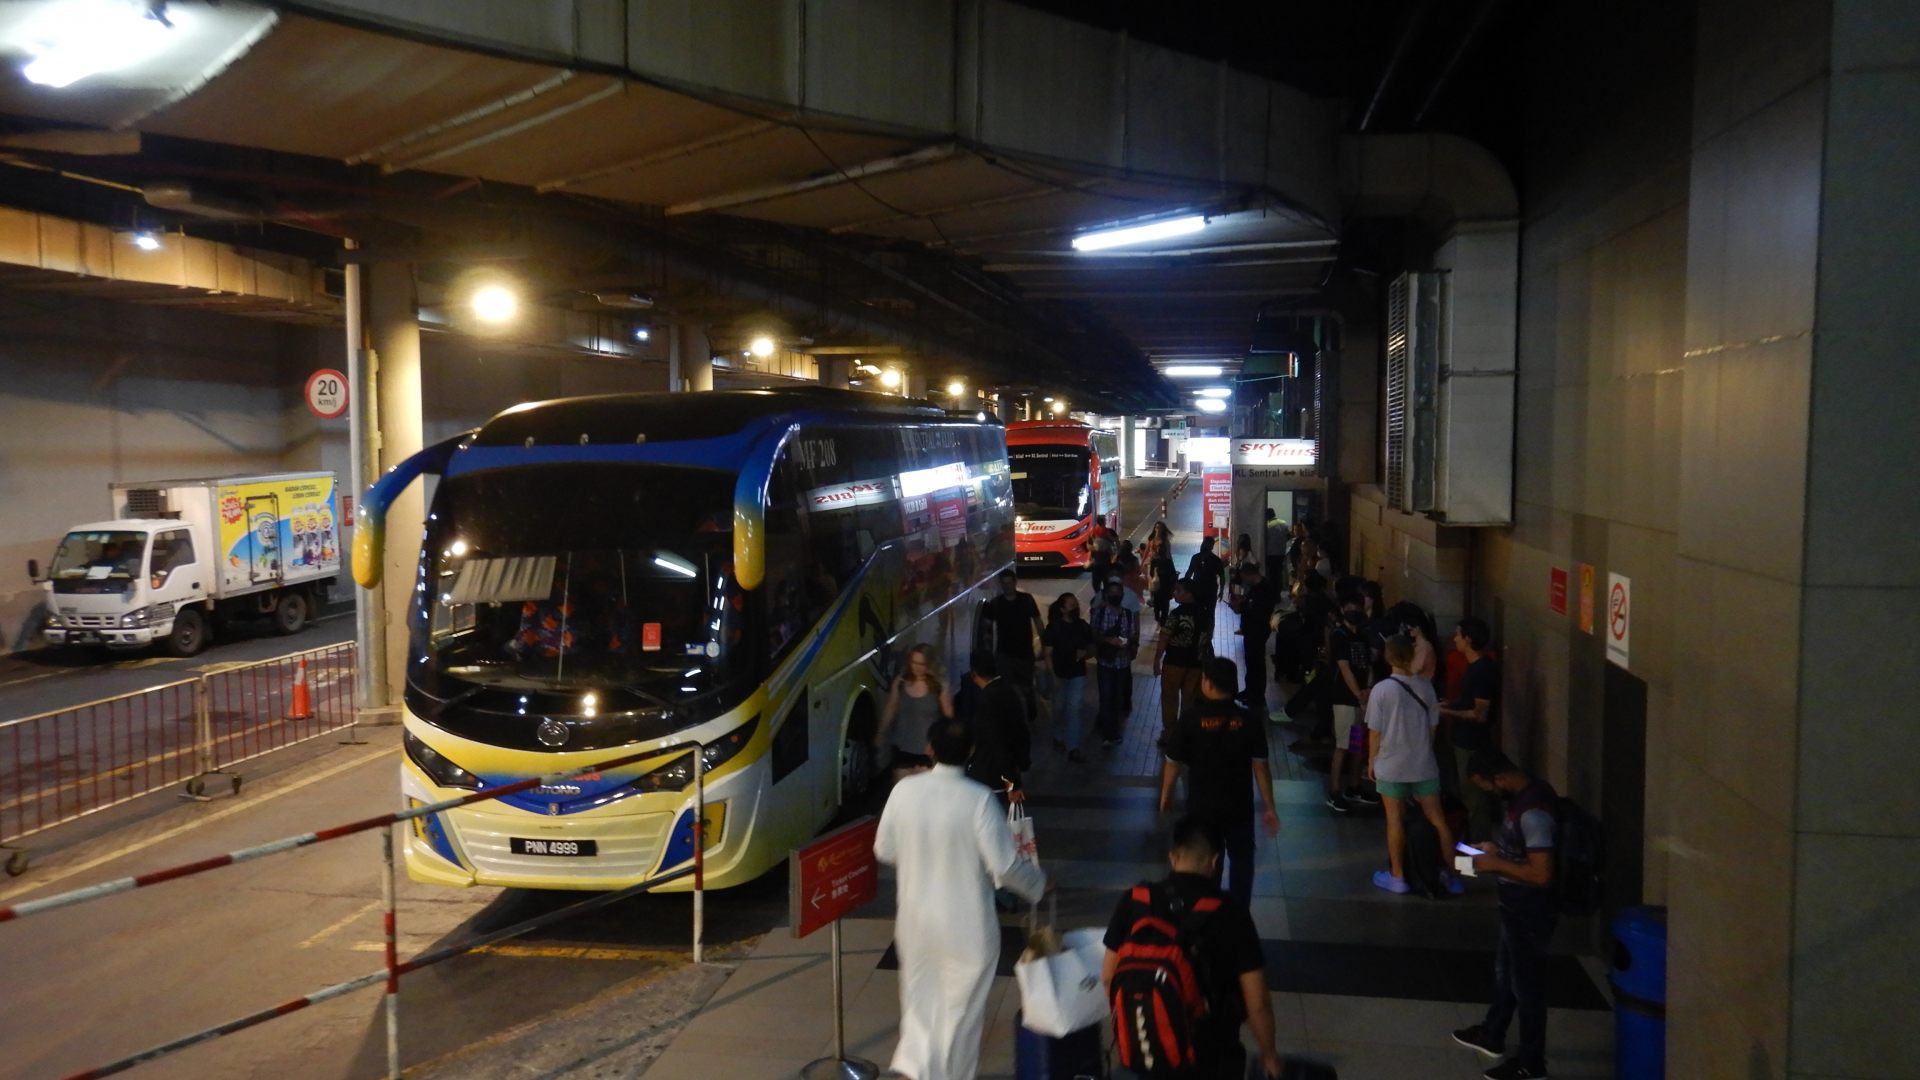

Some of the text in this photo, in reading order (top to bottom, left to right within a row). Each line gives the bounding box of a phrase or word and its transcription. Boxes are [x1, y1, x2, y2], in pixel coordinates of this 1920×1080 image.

[318, 379, 338, 396] 20
[318, 398, 337, 408] km/j
[798, 438, 837, 471] MF 208
[1248, 468, 1280, 478] Sentral
[525, 840, 578, 855] PNN 4999
